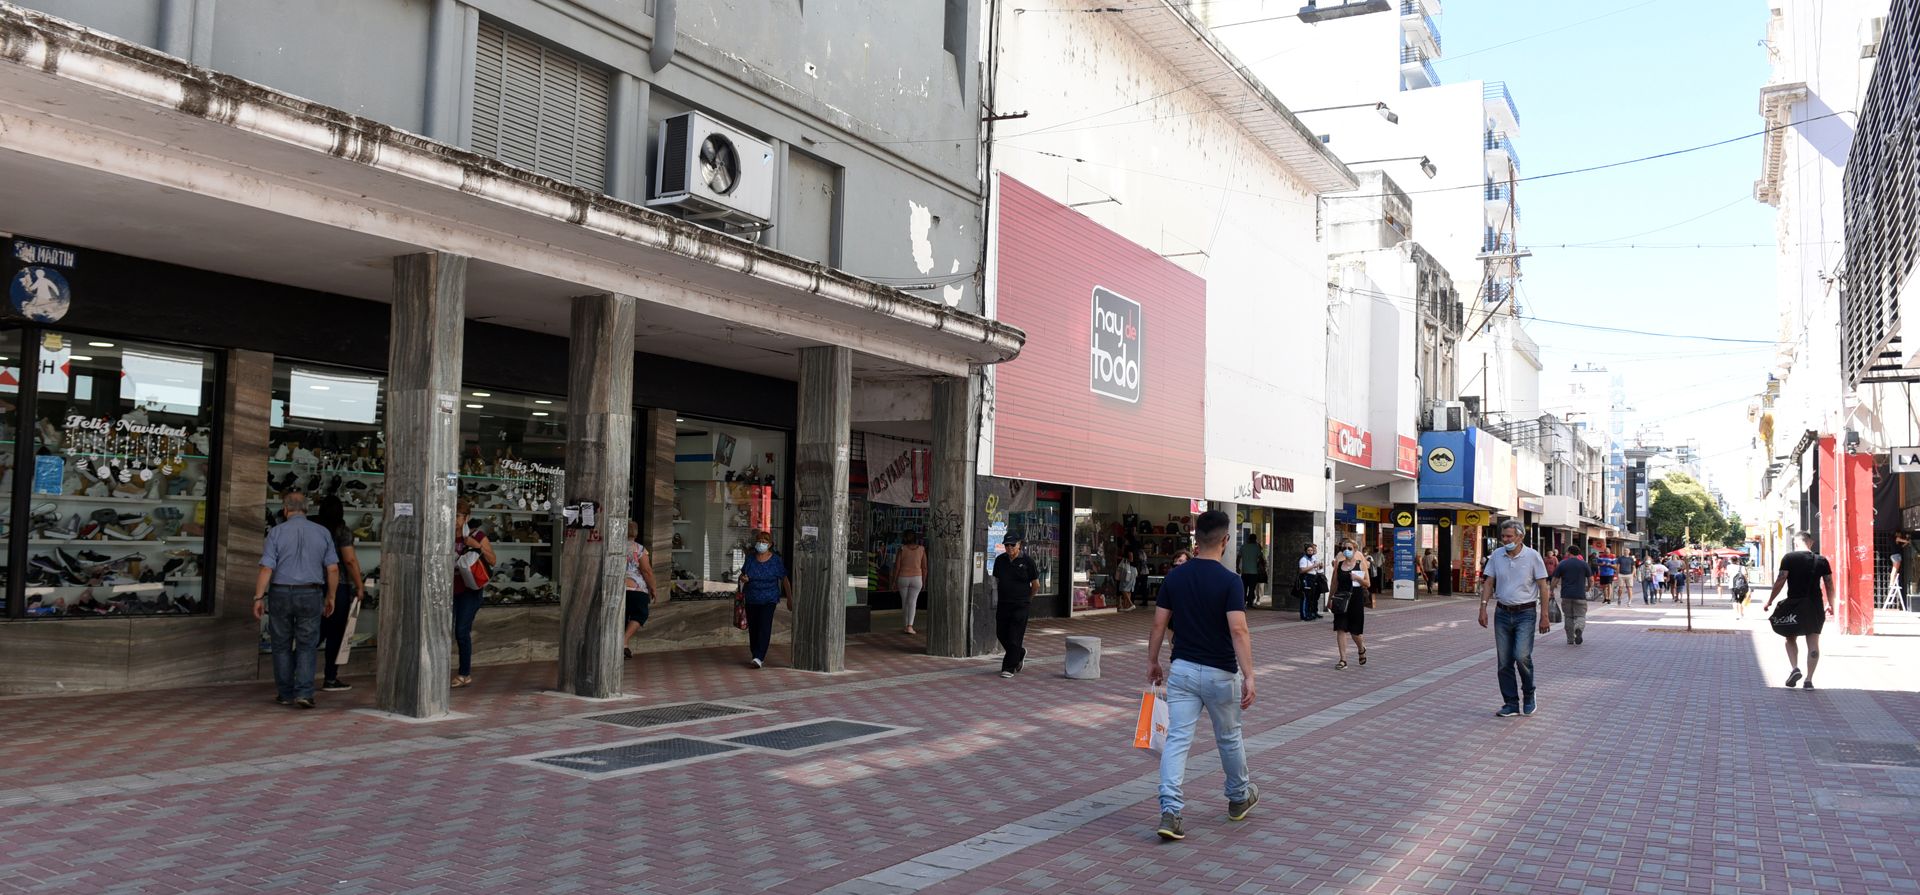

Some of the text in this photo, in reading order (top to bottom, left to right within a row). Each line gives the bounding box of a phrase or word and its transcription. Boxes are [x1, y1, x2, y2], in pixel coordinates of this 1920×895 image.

[37, 247, 74, 267] MARTIN
[1095, 295, 1137, 348] hay de
[1091, 332, 1139, 390] todo
[66, 415, 187, 438] Feliz Navidad
[1340, 428, 1363, 458] Claro
[501, 459, 566, 476] Feliz Navida
[1261, 473, 1295, 493] CECCHINI
